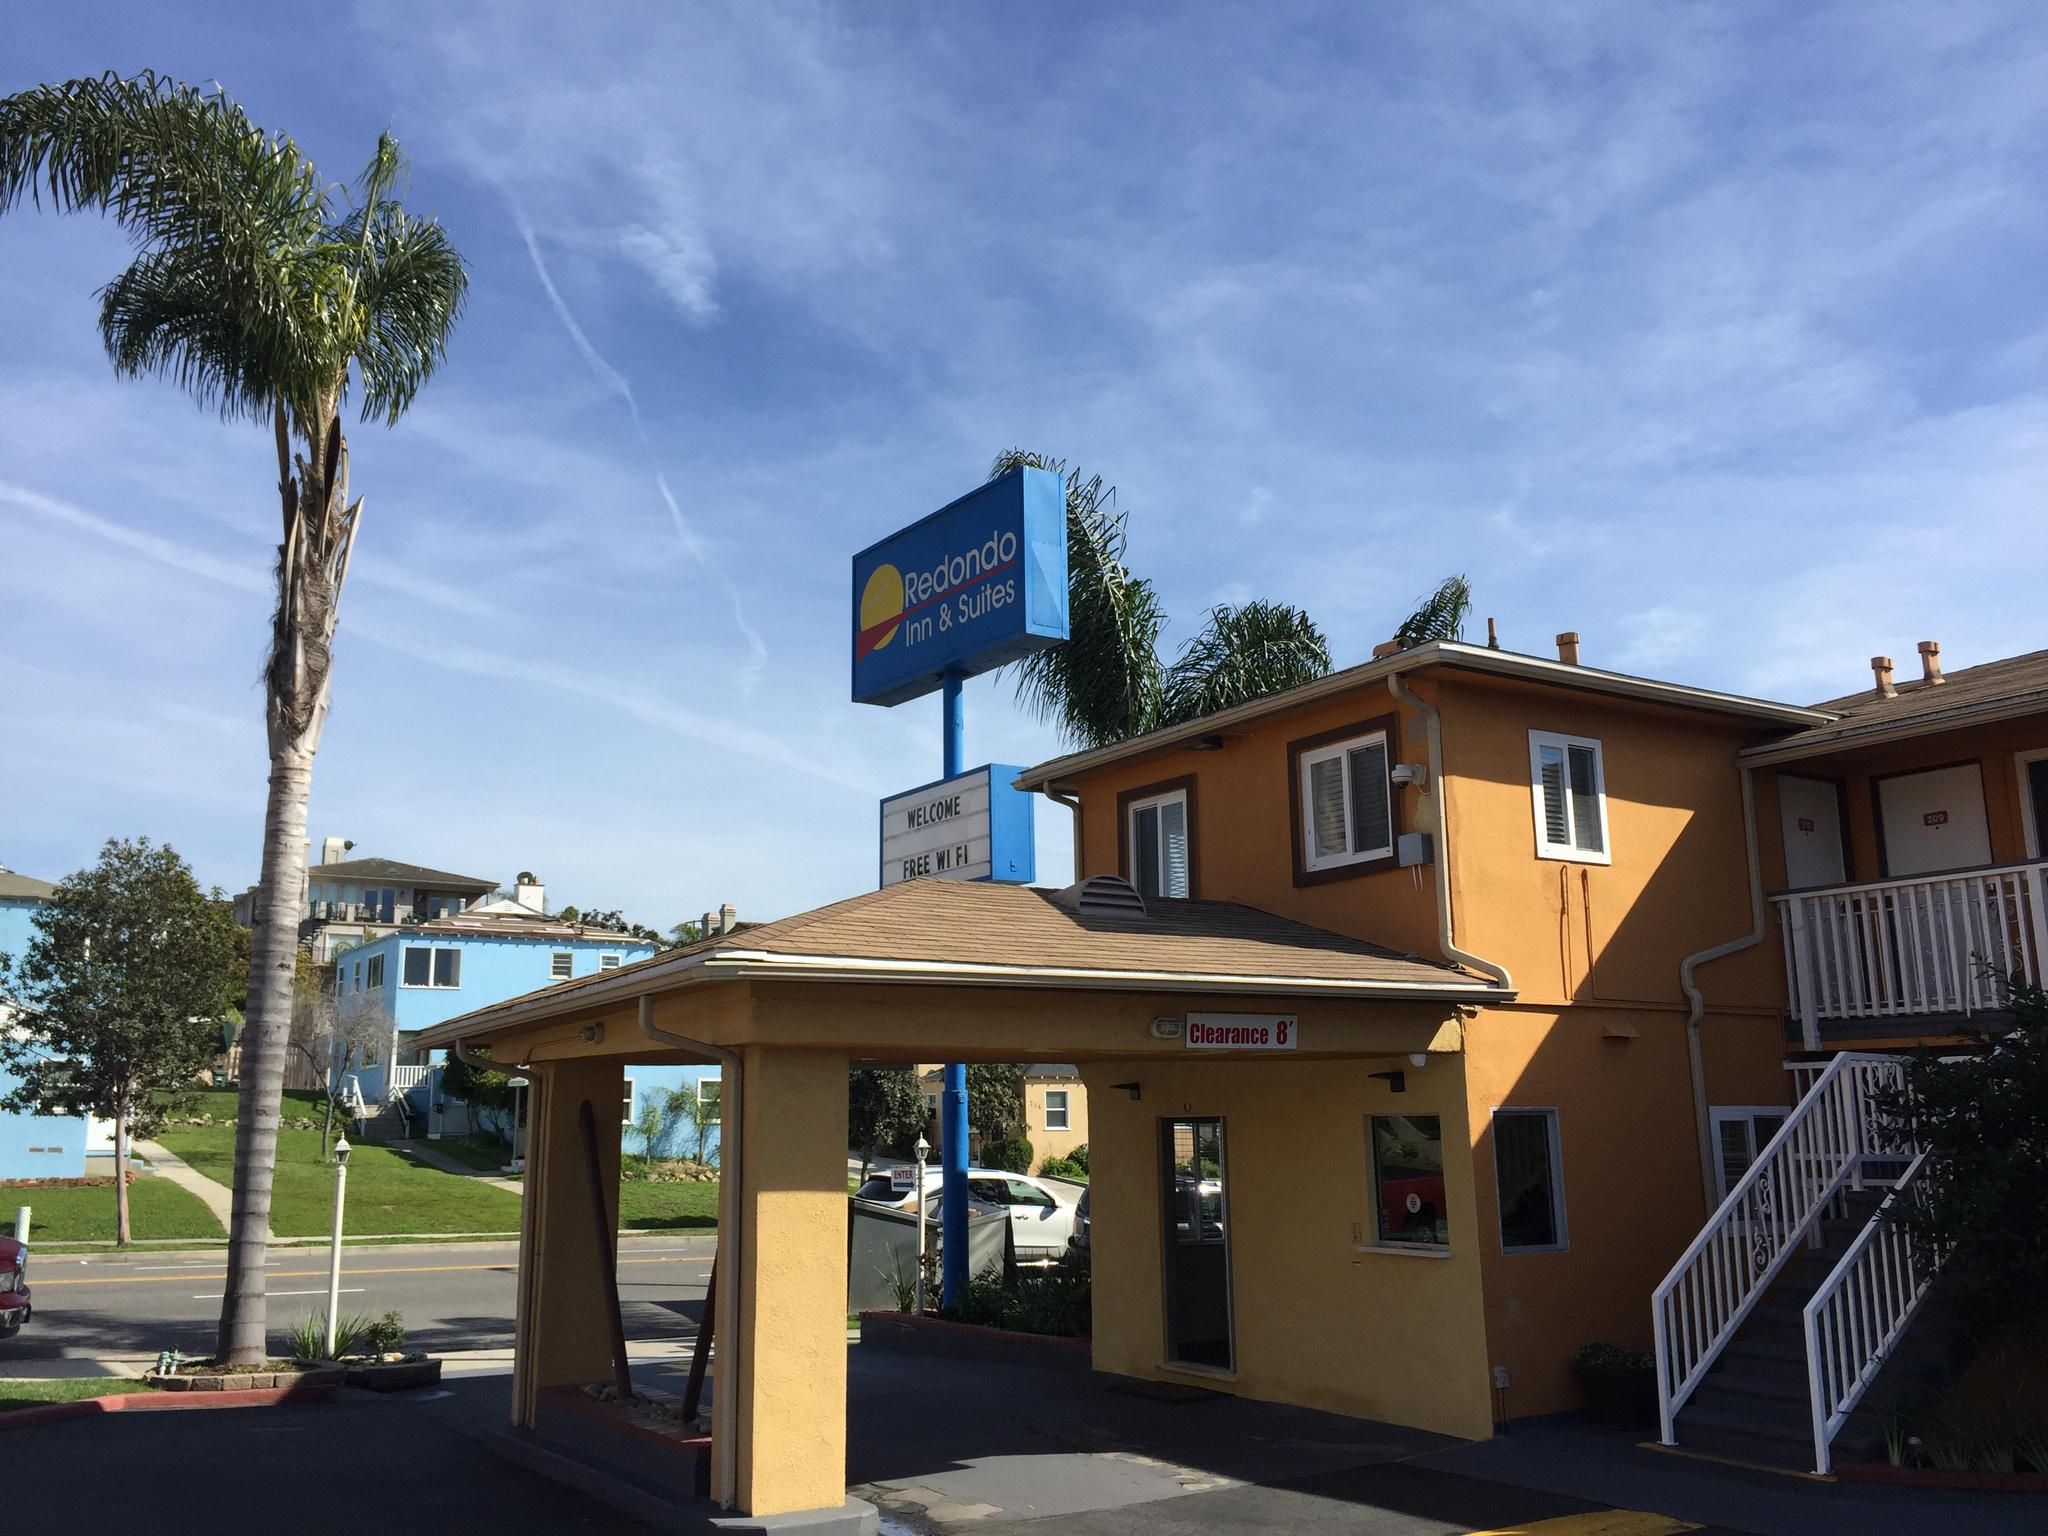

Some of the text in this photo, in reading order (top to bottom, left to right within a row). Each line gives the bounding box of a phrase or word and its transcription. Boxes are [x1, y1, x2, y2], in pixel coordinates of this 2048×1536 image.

[905, 530, 1017, 608] Redondo
[905, 579, 1015, 647] Inn & Suites
[908, 796, 960, 828] WELCOME
[903, 844, 968, 879] FREE WI FI
[1190, 1020, 1294, 1045] Clearance 8'
[893, 1170, 914, 1180] ENTER
